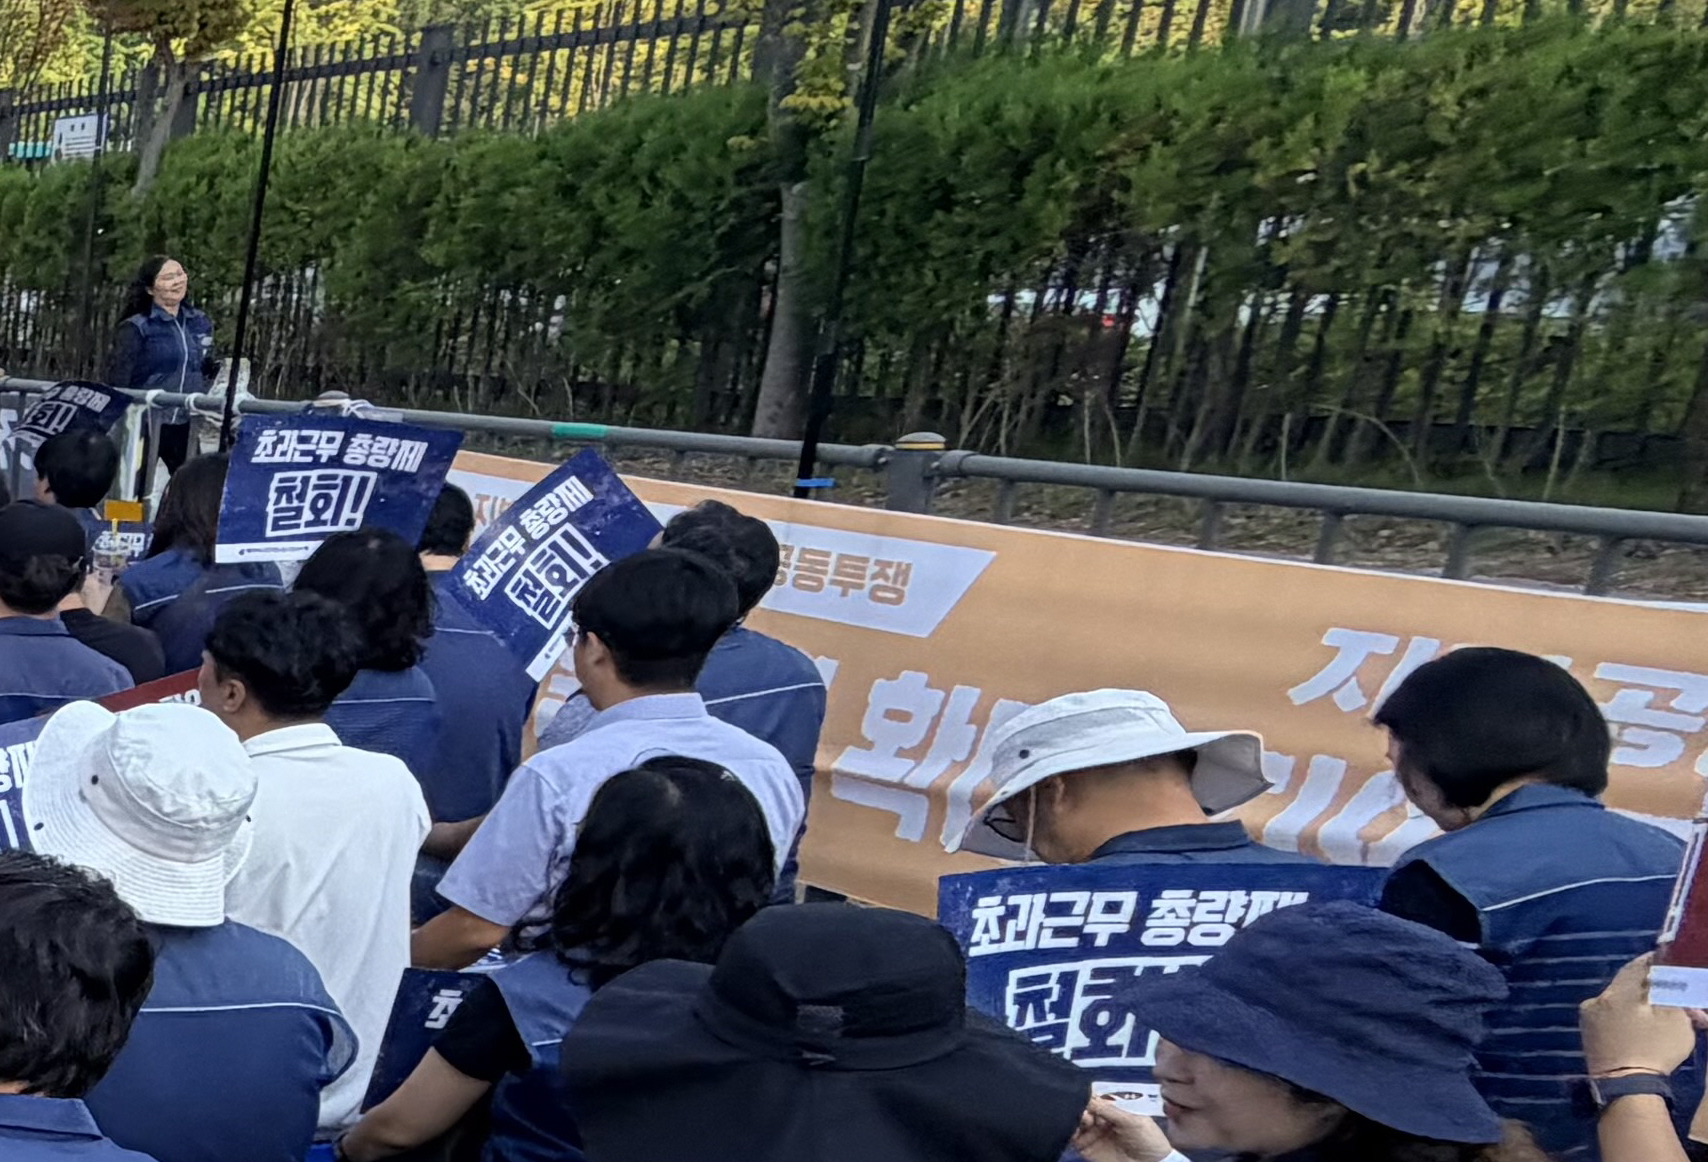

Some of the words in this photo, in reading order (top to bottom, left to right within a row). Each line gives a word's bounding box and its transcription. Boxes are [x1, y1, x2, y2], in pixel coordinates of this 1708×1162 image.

[250, 428, 345, 465] 초과근무
[342, 434, 429, 474] 총량제
[264, 468, 379, 537] 철회!
[519, 475, 595, 541] 총량제
[463, 524, 527, 601] 초과근무
[504, 522, 611, 631] 철회!
[968, 889, 1138, 959] 초과근무
